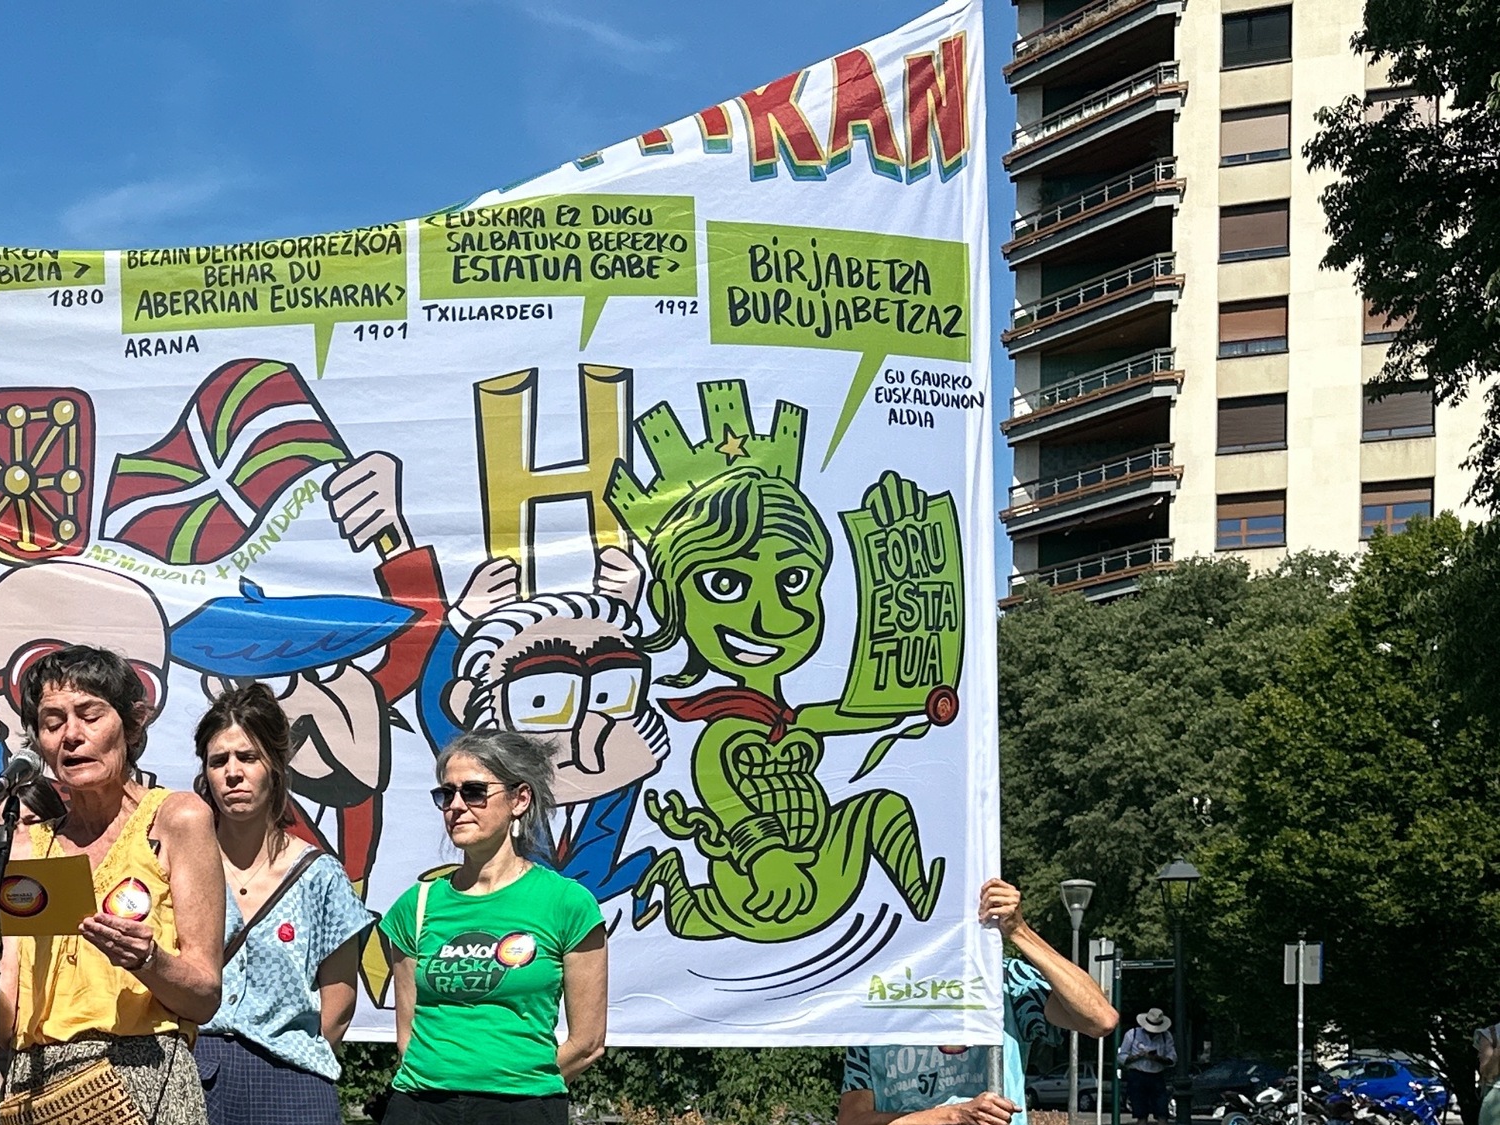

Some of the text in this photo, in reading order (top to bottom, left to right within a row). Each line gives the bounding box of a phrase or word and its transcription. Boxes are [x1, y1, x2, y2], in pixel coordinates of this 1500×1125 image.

[444, 205, 546, 229] EUSKARA
[555, 204, 582, 227] EZ
[592, 204, 654, 226] DUGU
[446, 230, 688, 254] SALBATUKO BEREZKO
[126, 247, 191, 270] BEZAIN
[452, 252, 582, 285] ESTATUA
[203, 260, 321, 288] BEHAR DU
[47, 288, 105, 308] 1880
[134, 288, 259, 322] ABERRIAN
[422, 298, 700, 322] TXILLARDEGI 1992
[124, 321, 408, 358] ARANA 1901
[884, 368, 973, 390] GU GAURKO
[874, 386, 985, 410] EUSKALDUNON
[887, 407, 935, 430] ALDIA
[230, 478, 321, 573] BANDERA
[864, 521, 948, 587] FORU
[868, 581, 958, 642] ESTA
[868, 631, 944, 691] TUA
[427, 958, 506, 974] EUSKA
[917, 1072, 938, 1098] 57
